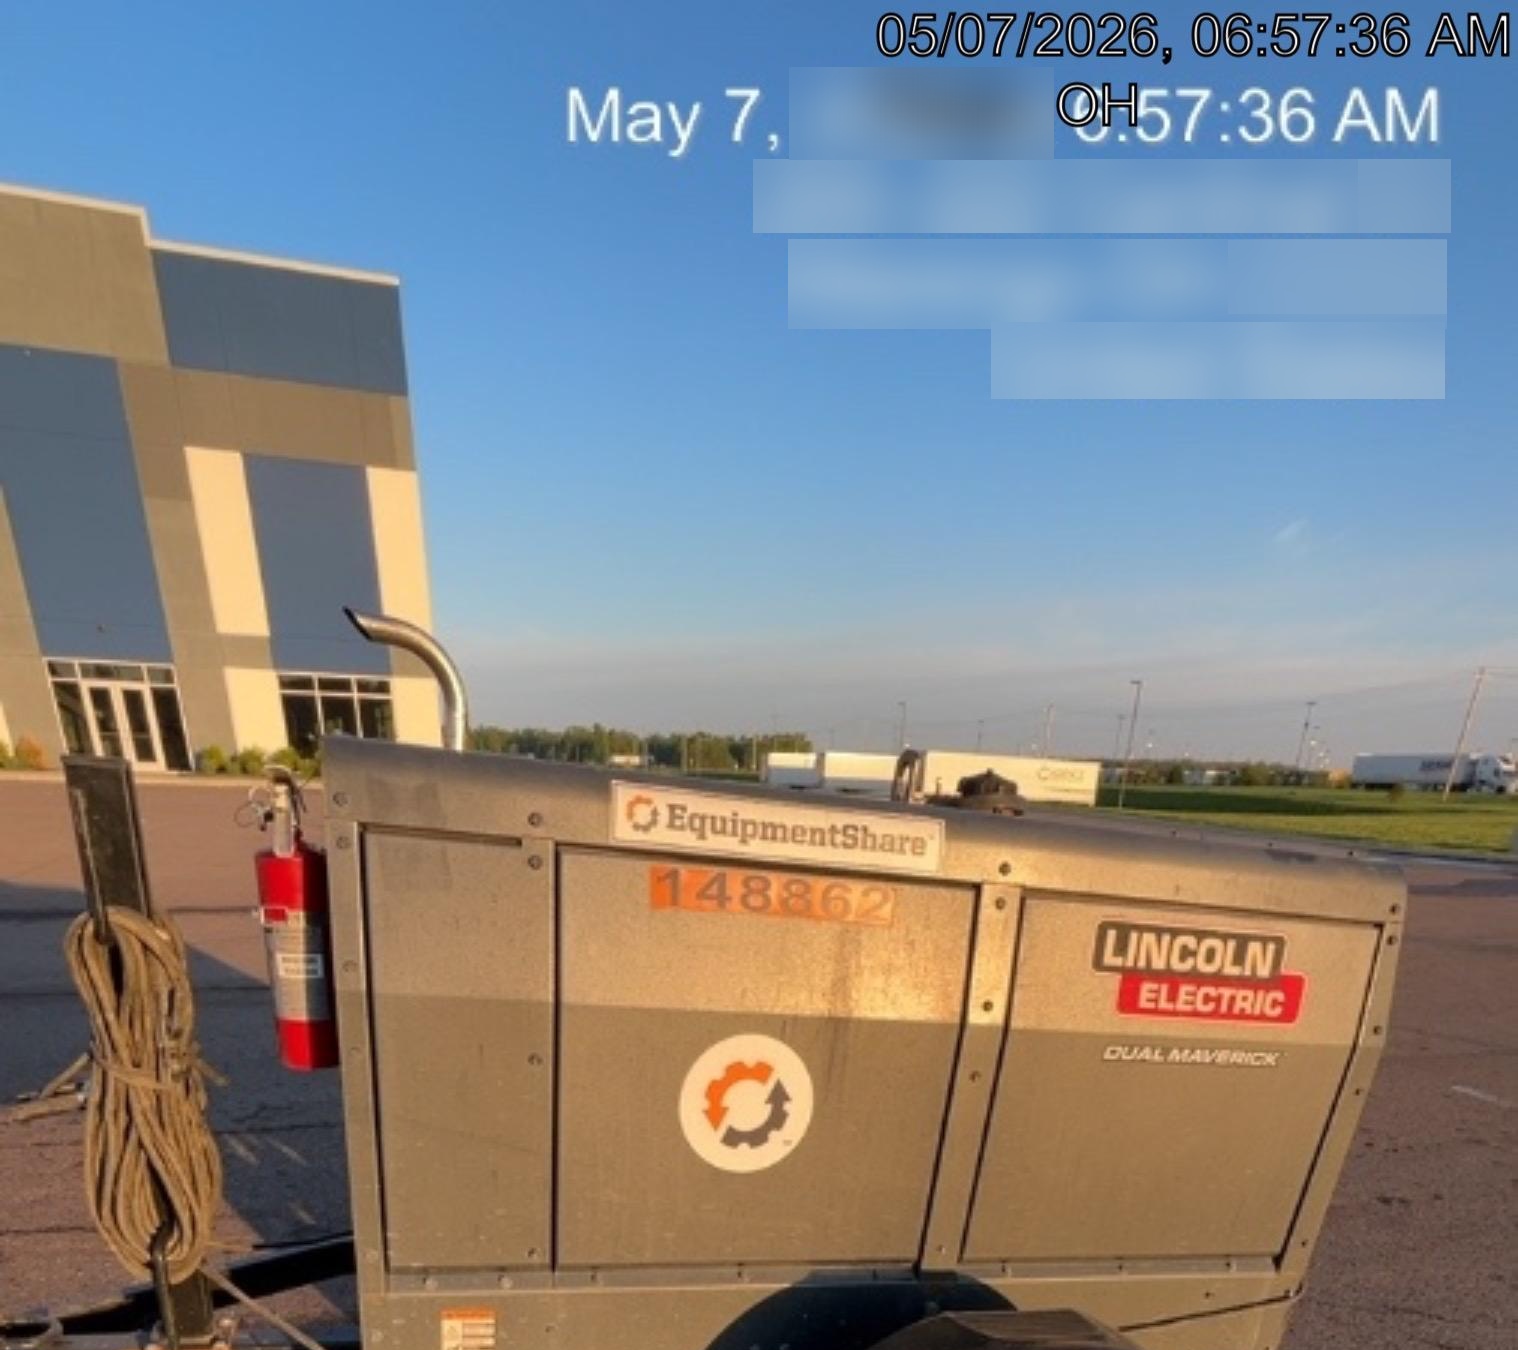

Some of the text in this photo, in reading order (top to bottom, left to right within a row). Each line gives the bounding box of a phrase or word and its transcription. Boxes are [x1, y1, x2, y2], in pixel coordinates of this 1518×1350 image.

[666, 803, 928, 857] EquipmentShare
[656, 867, 892, 922] 148862
[1102, 929, 1276, 978] LINCOLN
[1138, 981, 1285, 1017] ELECTRIC
[1103, 1046, 1281, 1066] DUAL MAVERICK
